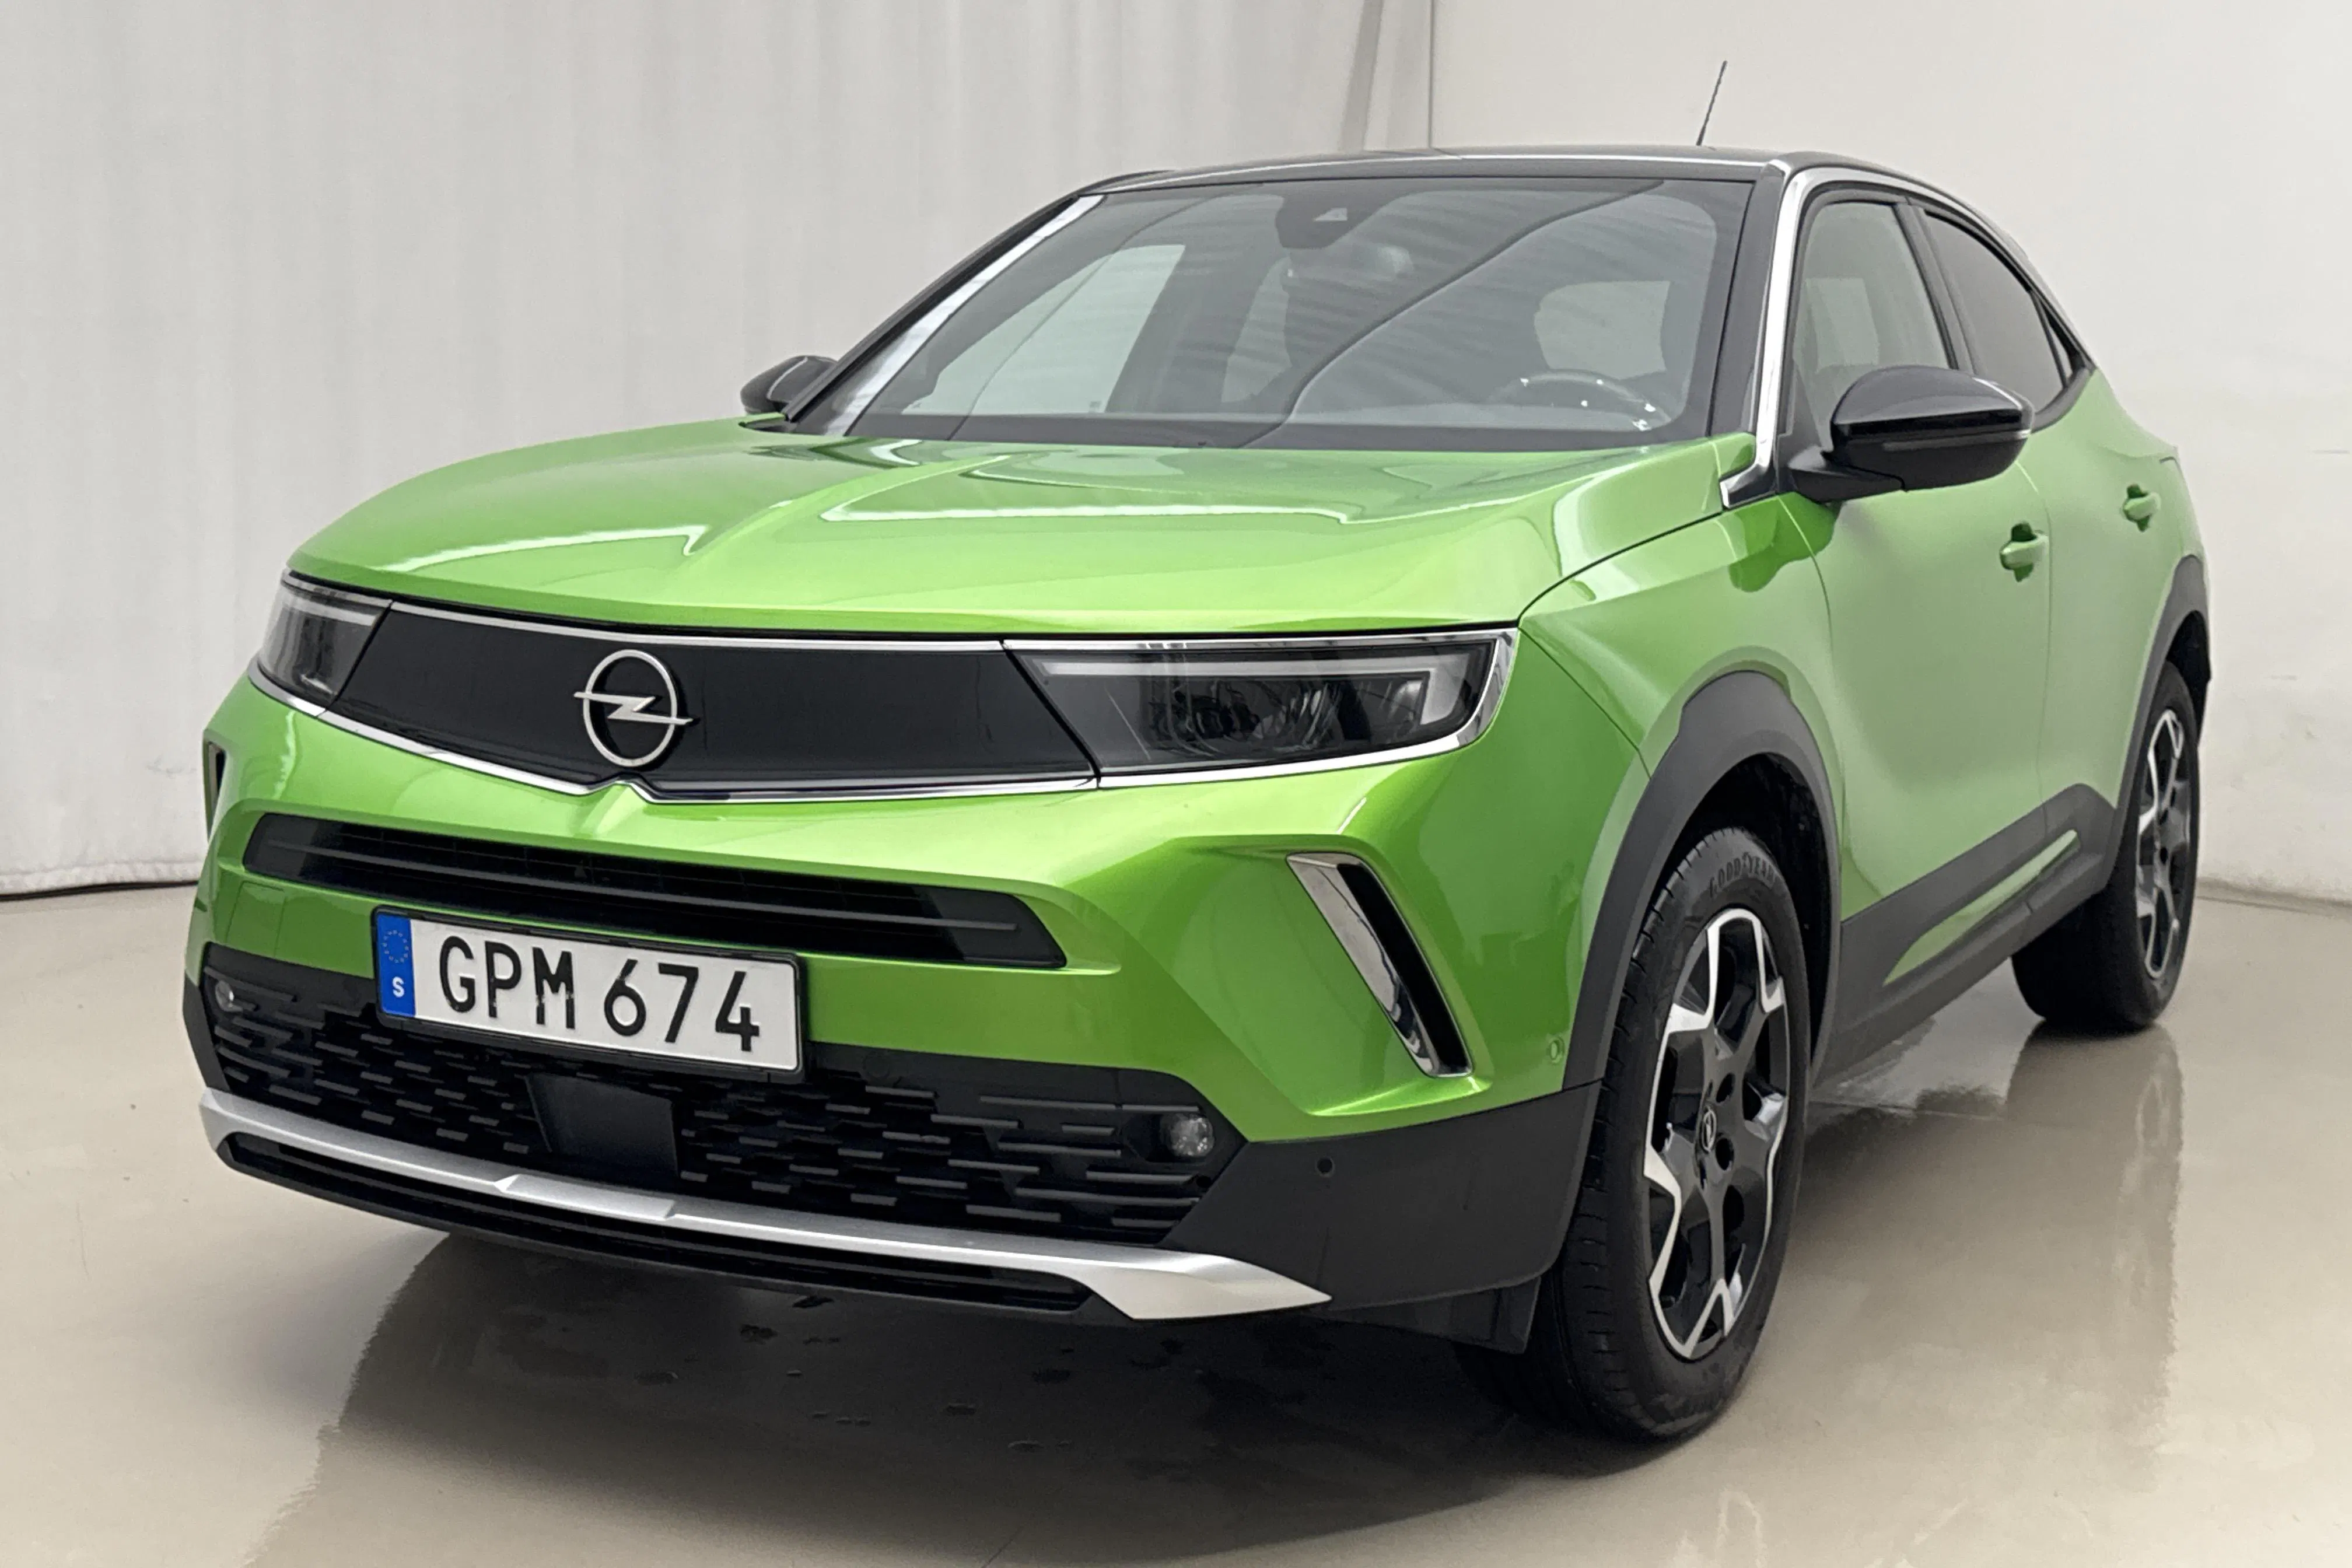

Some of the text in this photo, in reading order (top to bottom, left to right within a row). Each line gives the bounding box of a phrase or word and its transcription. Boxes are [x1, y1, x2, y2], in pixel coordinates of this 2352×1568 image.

[392, 976, 405, 998] S
[439, 935, 761, 1052] GPM 674
